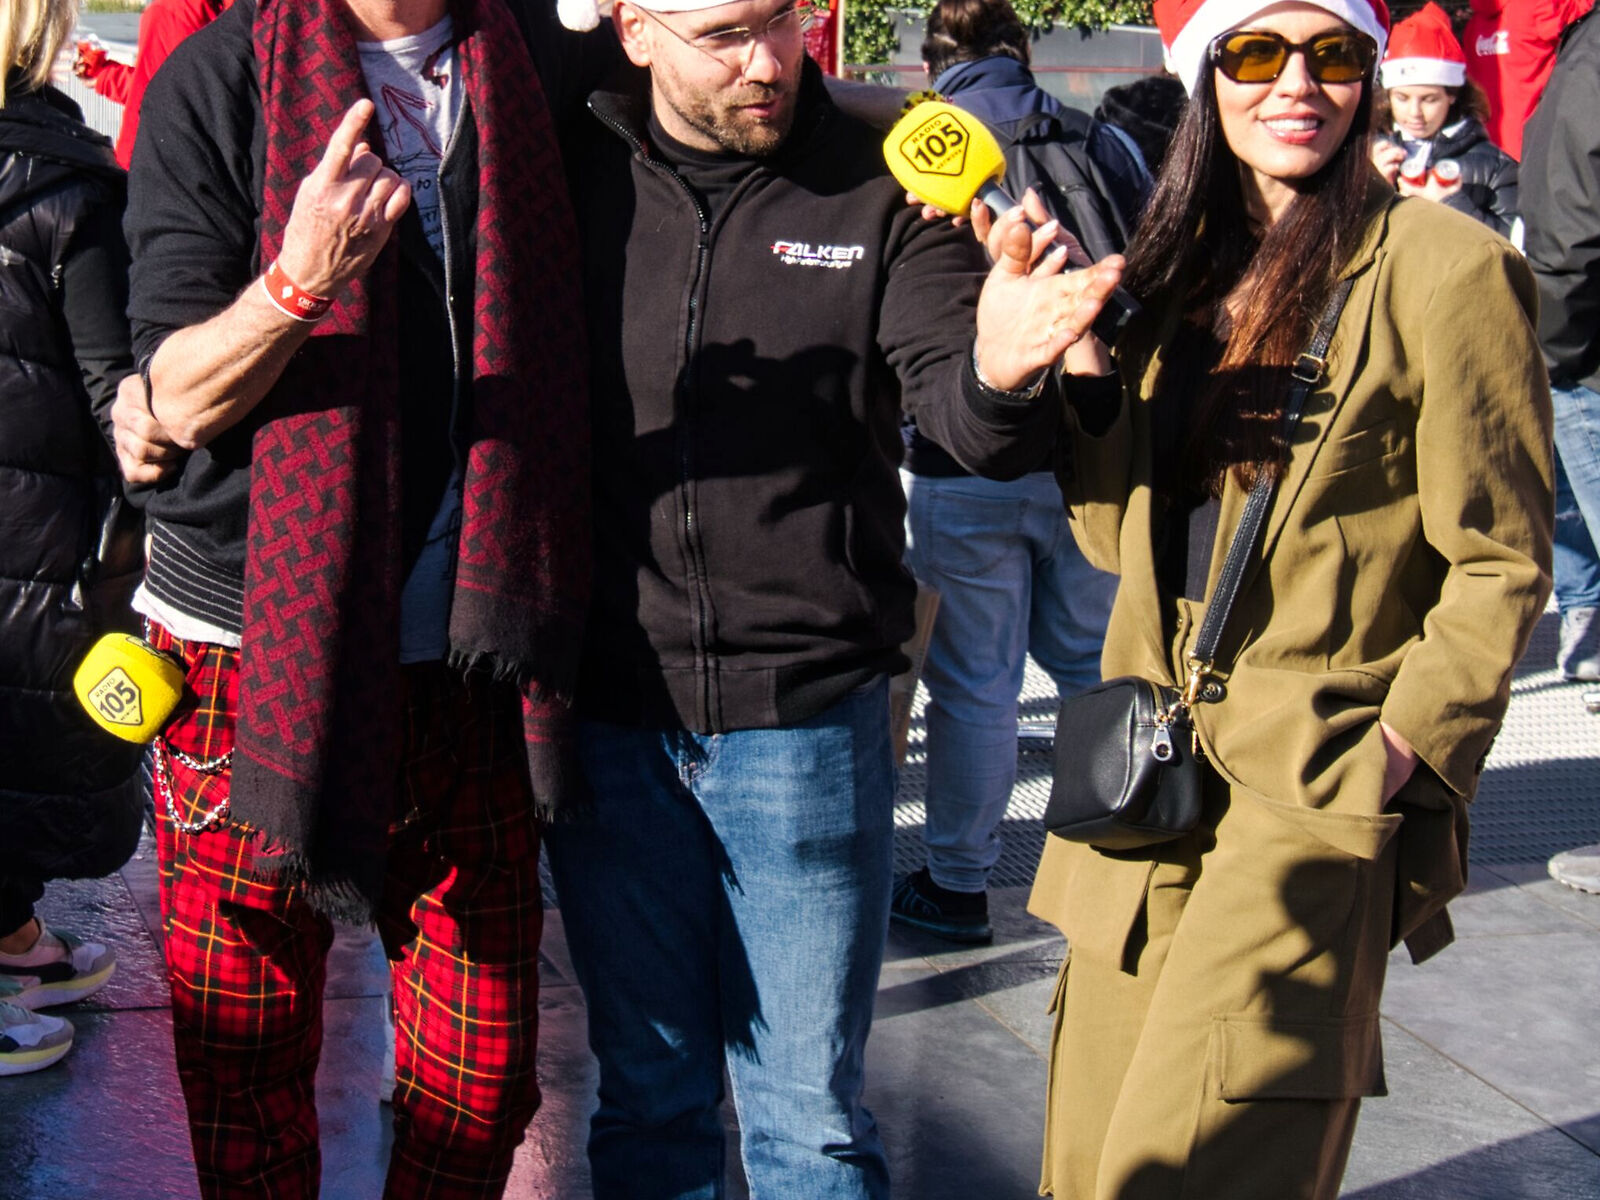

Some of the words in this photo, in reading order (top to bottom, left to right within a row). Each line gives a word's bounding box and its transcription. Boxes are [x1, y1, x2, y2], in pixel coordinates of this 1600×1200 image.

[912, 119, 943, 144] RADIO
[914, 123, 964, 167] 105
[770, 240, 865, 260] FALKEN
[99, 680, 137, 720] 105
